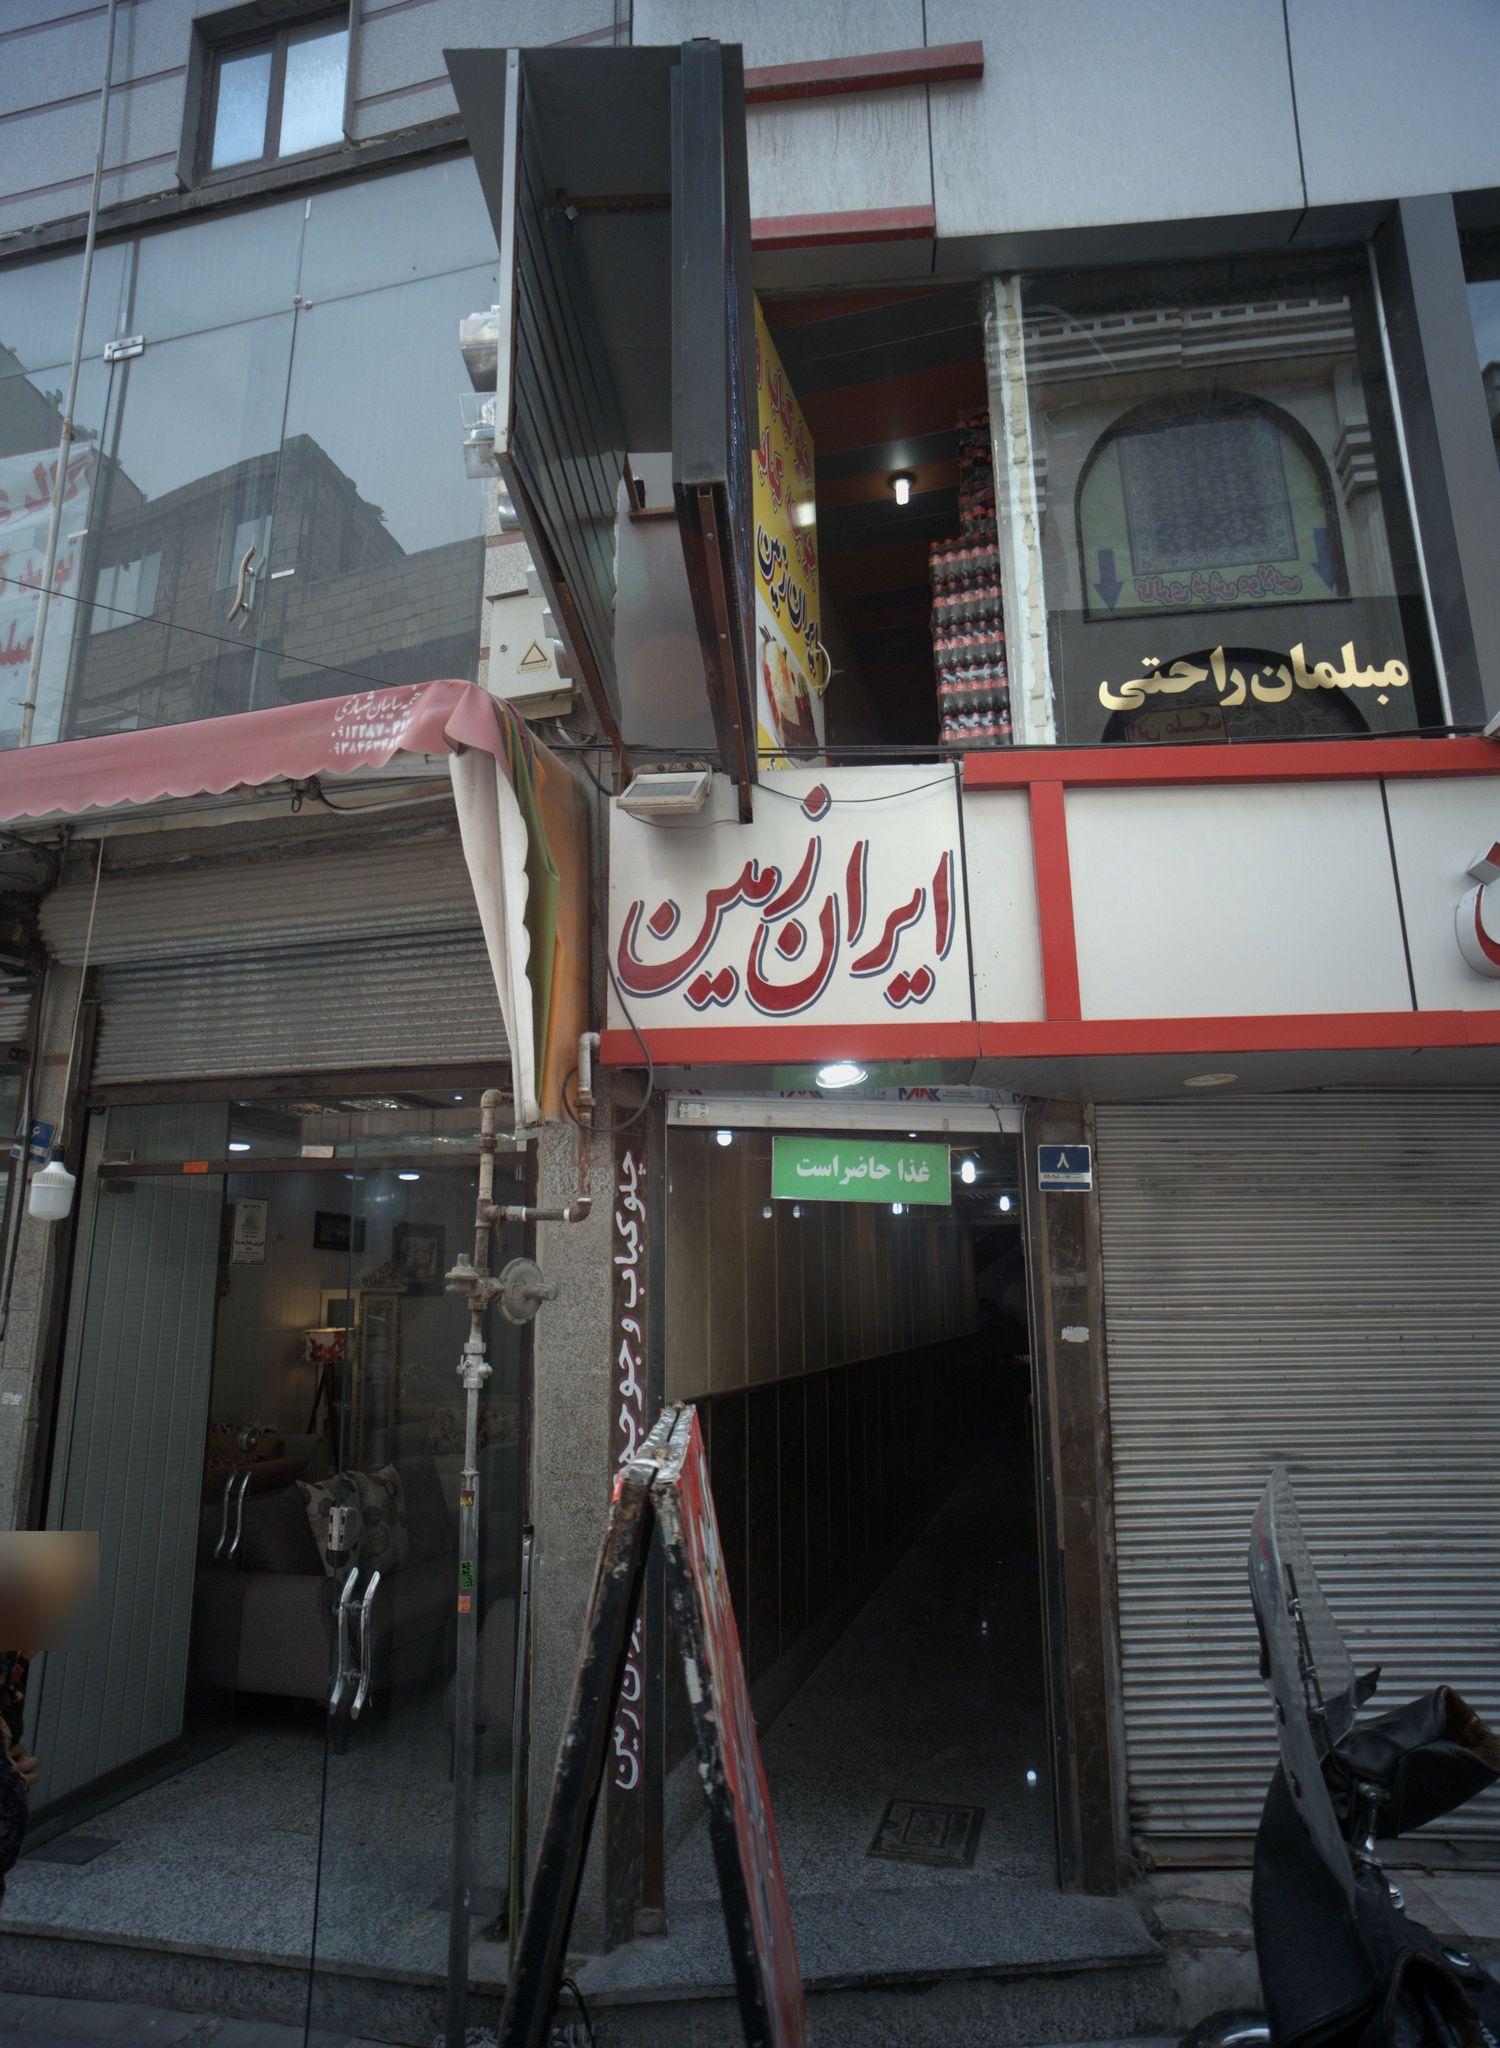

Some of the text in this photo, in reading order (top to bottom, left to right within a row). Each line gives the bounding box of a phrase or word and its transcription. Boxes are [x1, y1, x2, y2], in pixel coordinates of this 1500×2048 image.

[757, 521, 788, 619] زمین
[1099, 640, 1410, 711] مبلمان راحتی
[616, 782, 957, 1018] ایران زمین
[796, 1153, 930, 1185] غذا حاضر است
[1056, 1152, 1070, 1169] ۸
